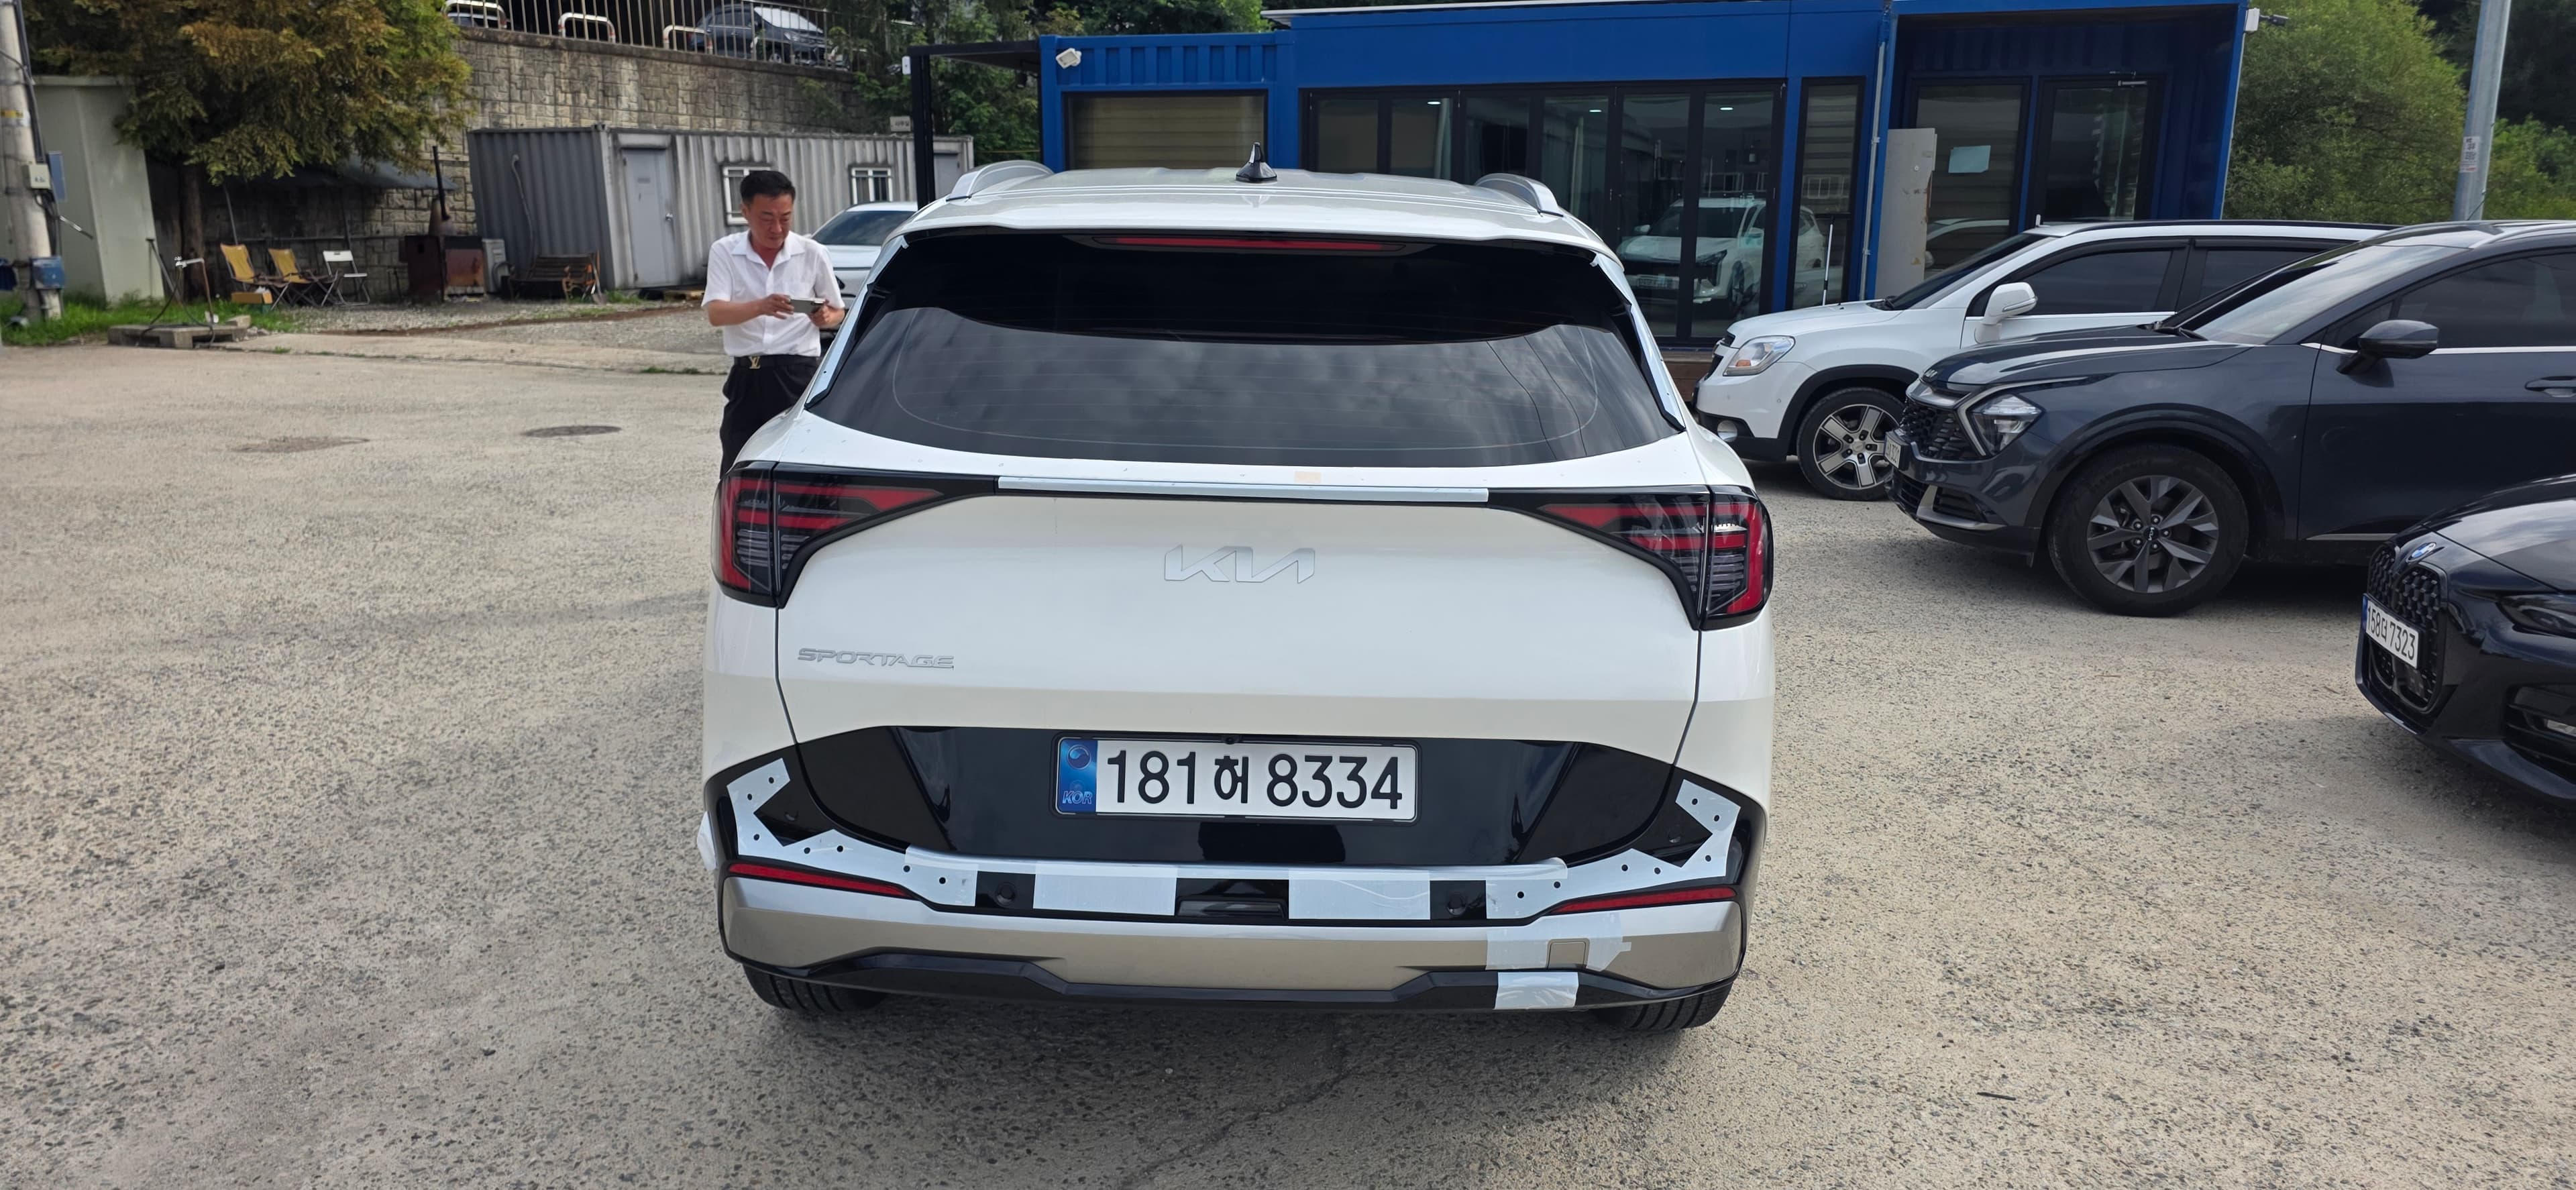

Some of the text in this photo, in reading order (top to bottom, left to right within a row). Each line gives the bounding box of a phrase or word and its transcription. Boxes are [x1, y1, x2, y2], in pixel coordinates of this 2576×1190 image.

[2390, 621, 2416, 660] 7323
[798, 648, 954, 669] SPORTAGE
[1267, 753, 1403, 809] 8334
[1063, 790, 1092, 804] KOR
